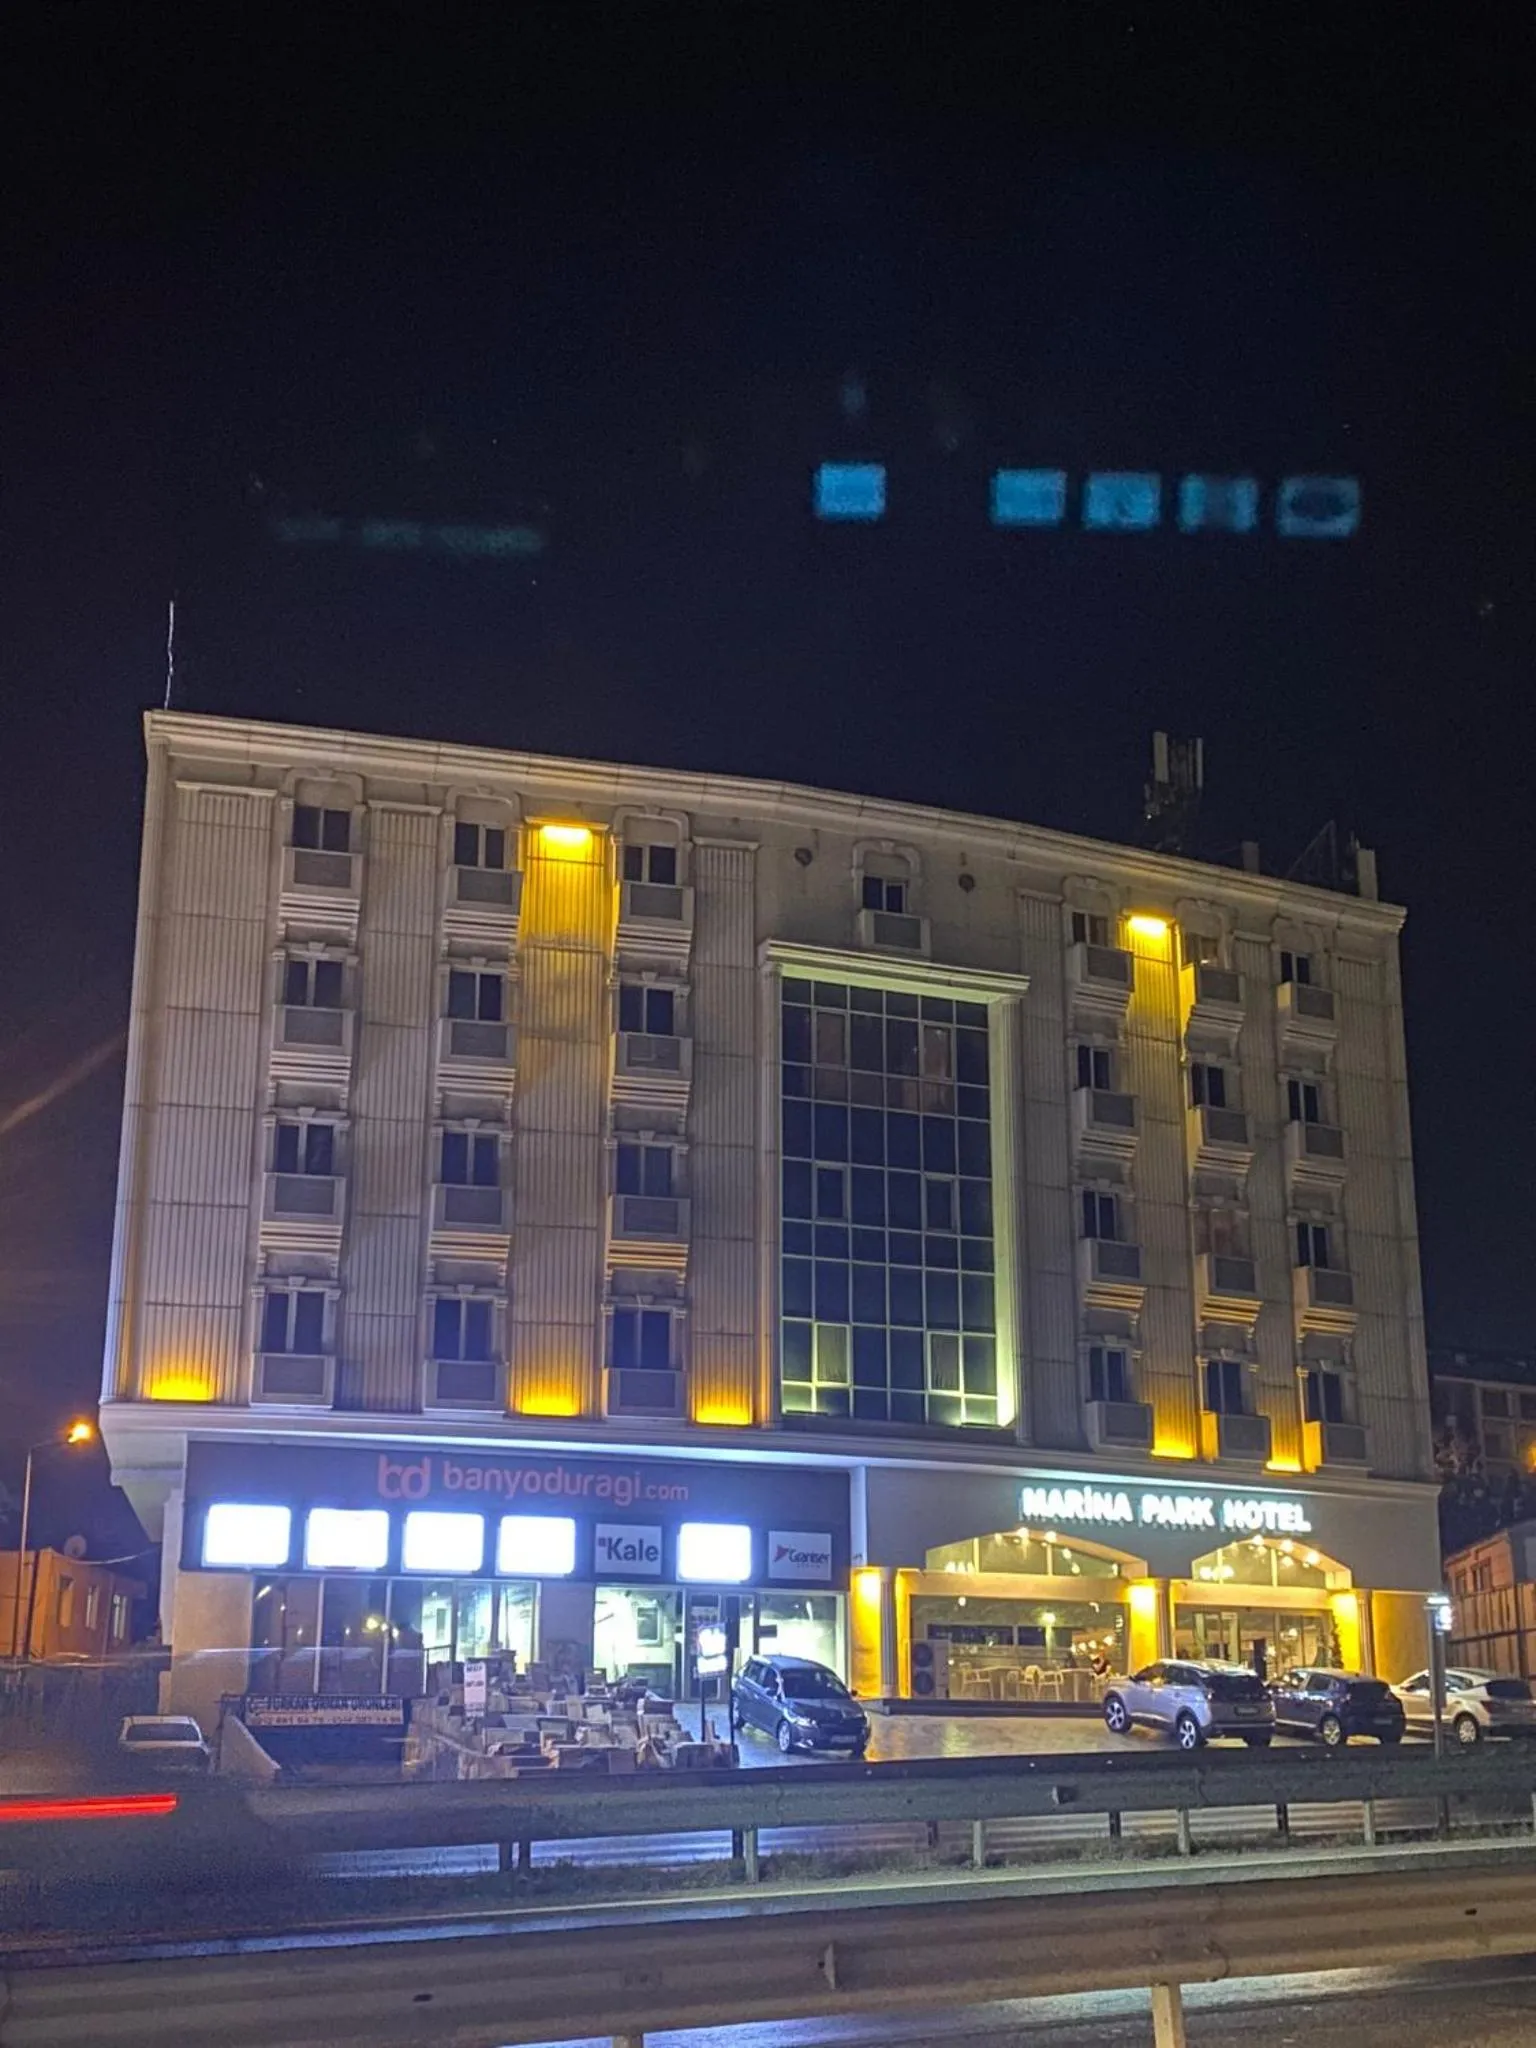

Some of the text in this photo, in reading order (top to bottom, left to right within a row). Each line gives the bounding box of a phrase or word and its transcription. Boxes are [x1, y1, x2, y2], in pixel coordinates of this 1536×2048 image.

[443, 1461, 690, 1507] banyoduragi.com
[1141, 1494, 1216, 1526] PARK
[1222, 1498, 1312, 1532] HOTEL
[607, 1536, 660, 1562] Kale
